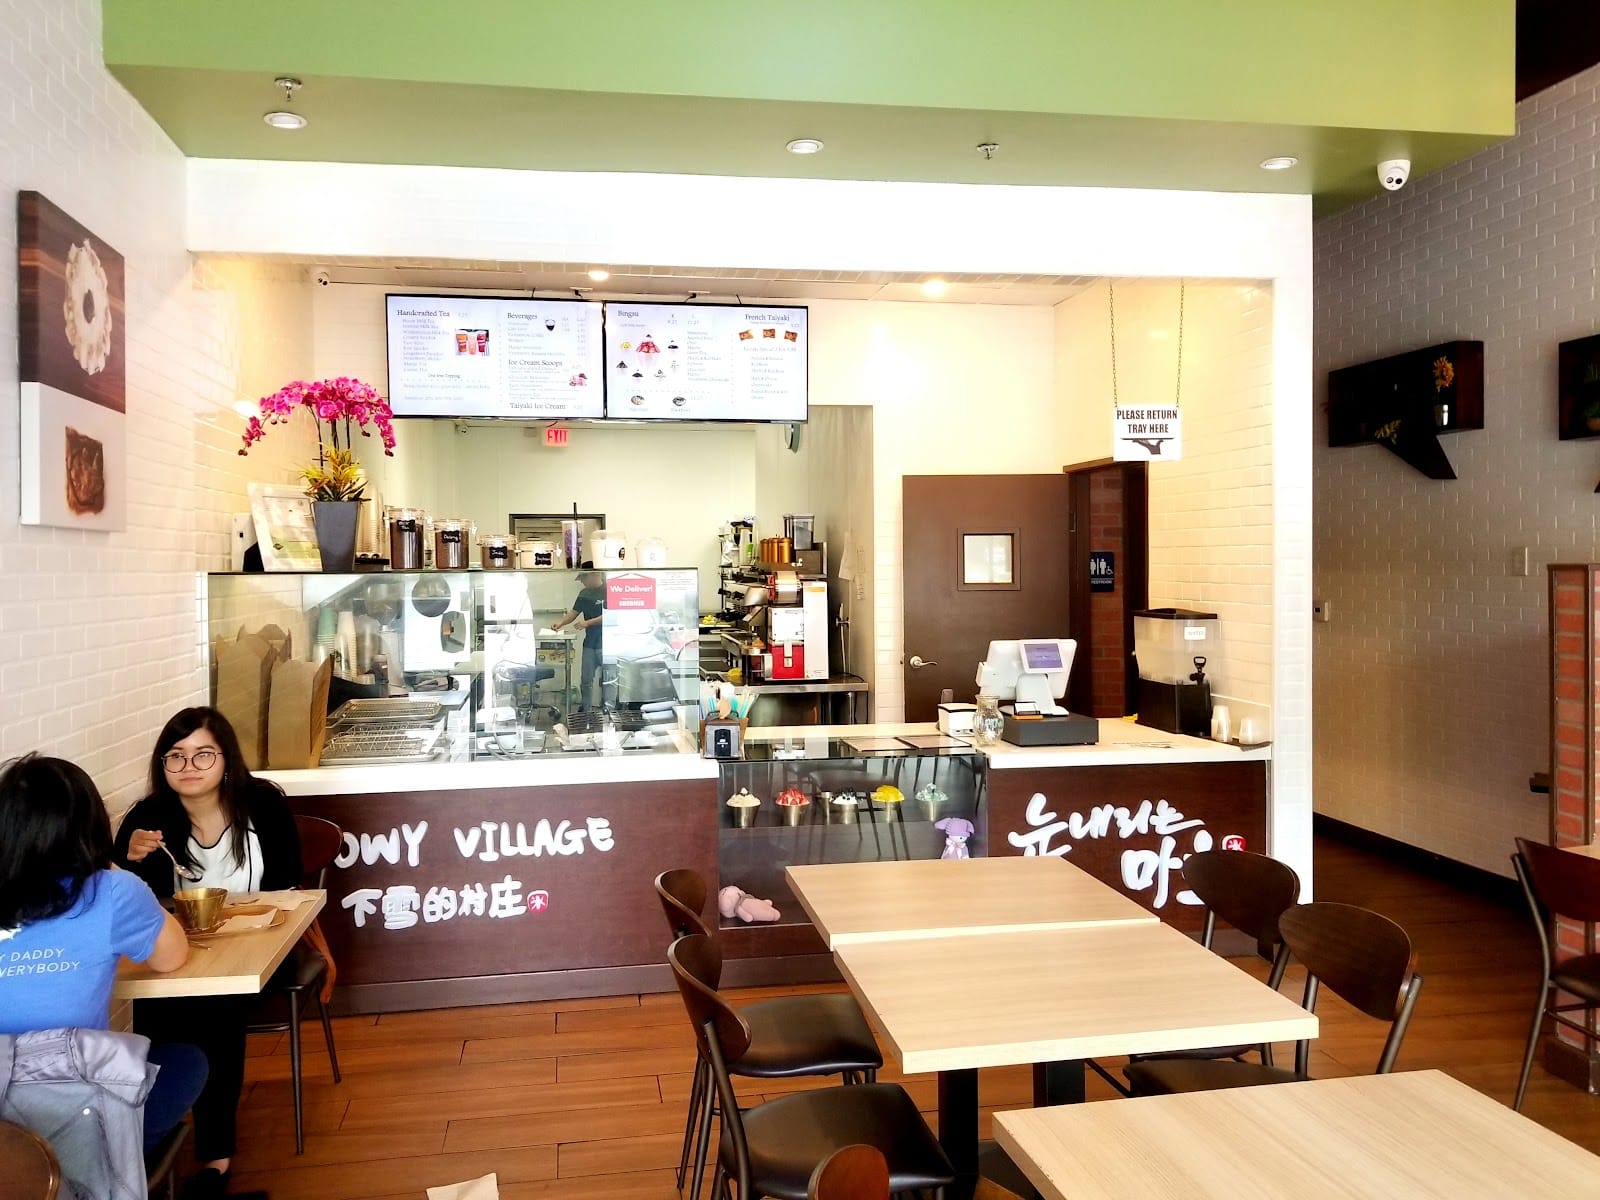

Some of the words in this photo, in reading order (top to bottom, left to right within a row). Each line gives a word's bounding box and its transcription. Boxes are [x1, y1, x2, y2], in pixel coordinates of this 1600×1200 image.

[397, 309, 437, 317] Handcrafted
[507, 312, 538, 320] Beverages
[745, 313, 766, 321] French
[767, 314, 790, 322] Taiyaki
[510, 402, 533, 410] Taiyaki
[1116, 410, 1145, 420] PLEASE
[1146, 409, 1178, 419] RETURN
[1128, 424, 1147, 434] TRAY
[1149, 423, 1169, 433] HERE
[547, 429, 568, 443] EXIT
[610, 585, 623, 593] We
[624, 585, 653, 593] Deliver!
[453, 817, 615, 862] VILLAGE
[10, 948, 65, 962] DADDY
